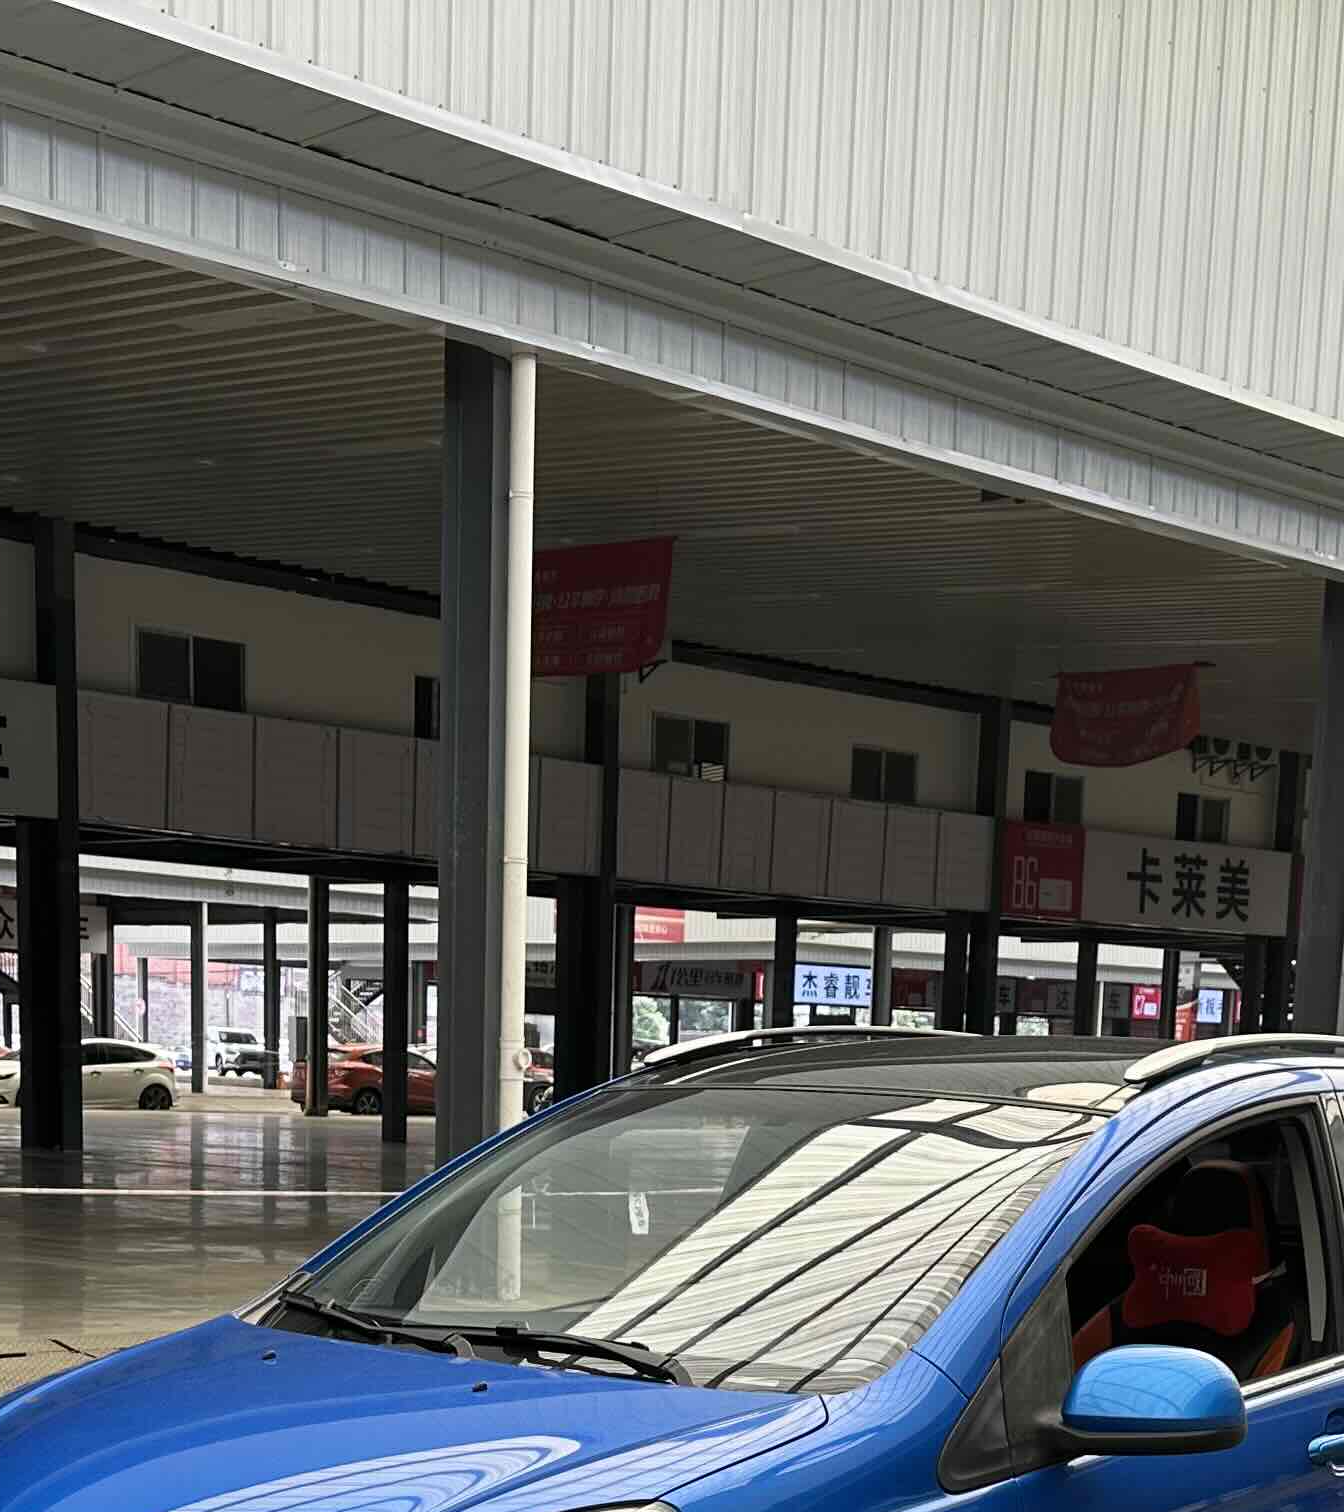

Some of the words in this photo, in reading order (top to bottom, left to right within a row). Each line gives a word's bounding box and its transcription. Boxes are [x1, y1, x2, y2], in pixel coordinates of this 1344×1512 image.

[1012, 855, 1039, 911] B6
[1126, 848, 1251, 922] 卡莱美
